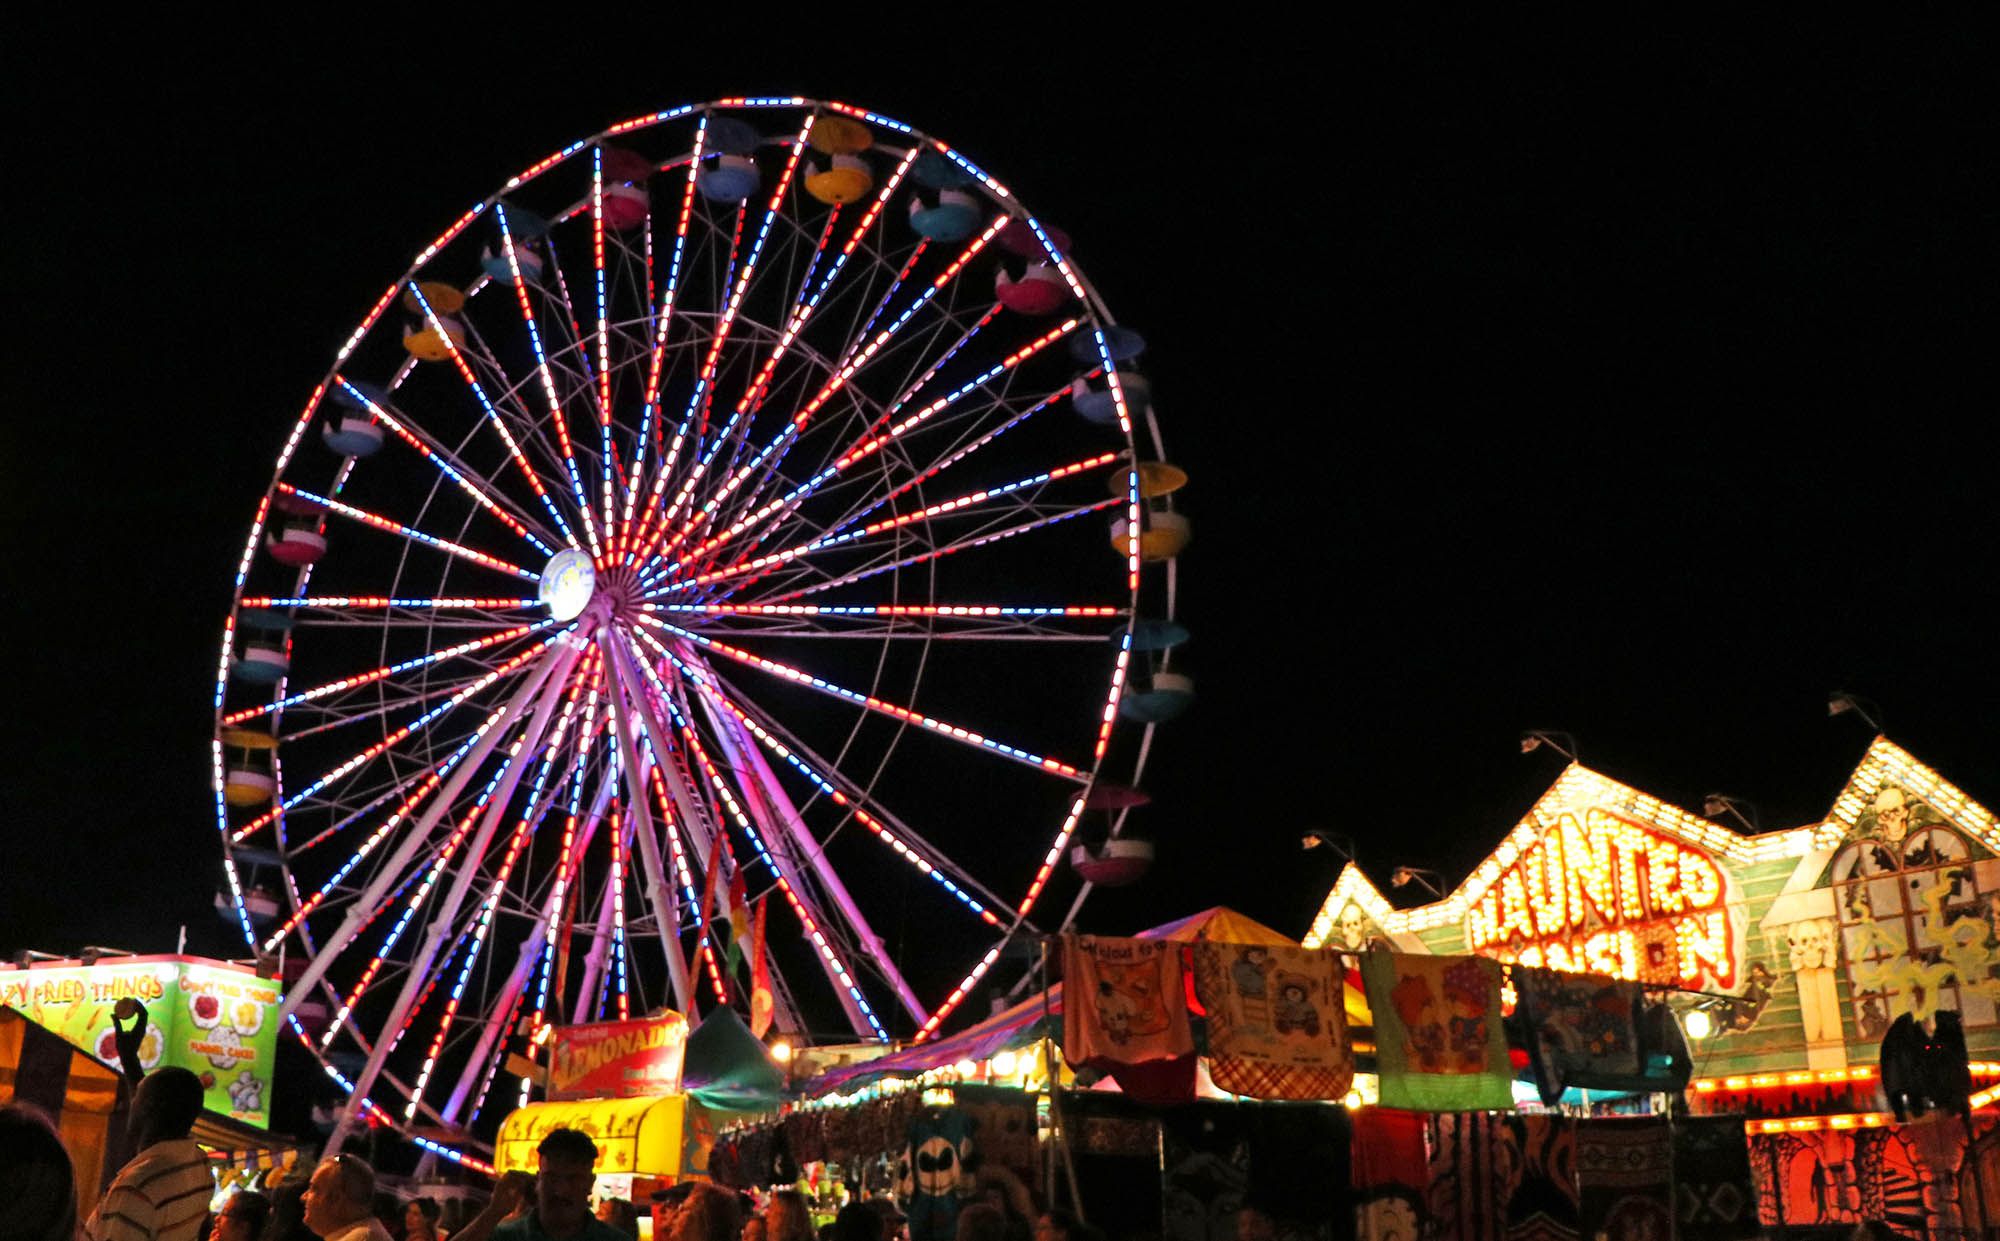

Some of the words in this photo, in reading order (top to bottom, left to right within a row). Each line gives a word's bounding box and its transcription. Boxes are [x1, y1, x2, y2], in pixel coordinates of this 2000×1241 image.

[1467, 807, 1721, 949] HAUNTED
[1499, 908, 1732, 993] NSION
[0, 978, 30, 1007] ZY
[33, 979, 86, 1004] FRIED
[91, 974, 164, 1002] THINGS
[552, 1021, 684, 1091] LEMONADE
